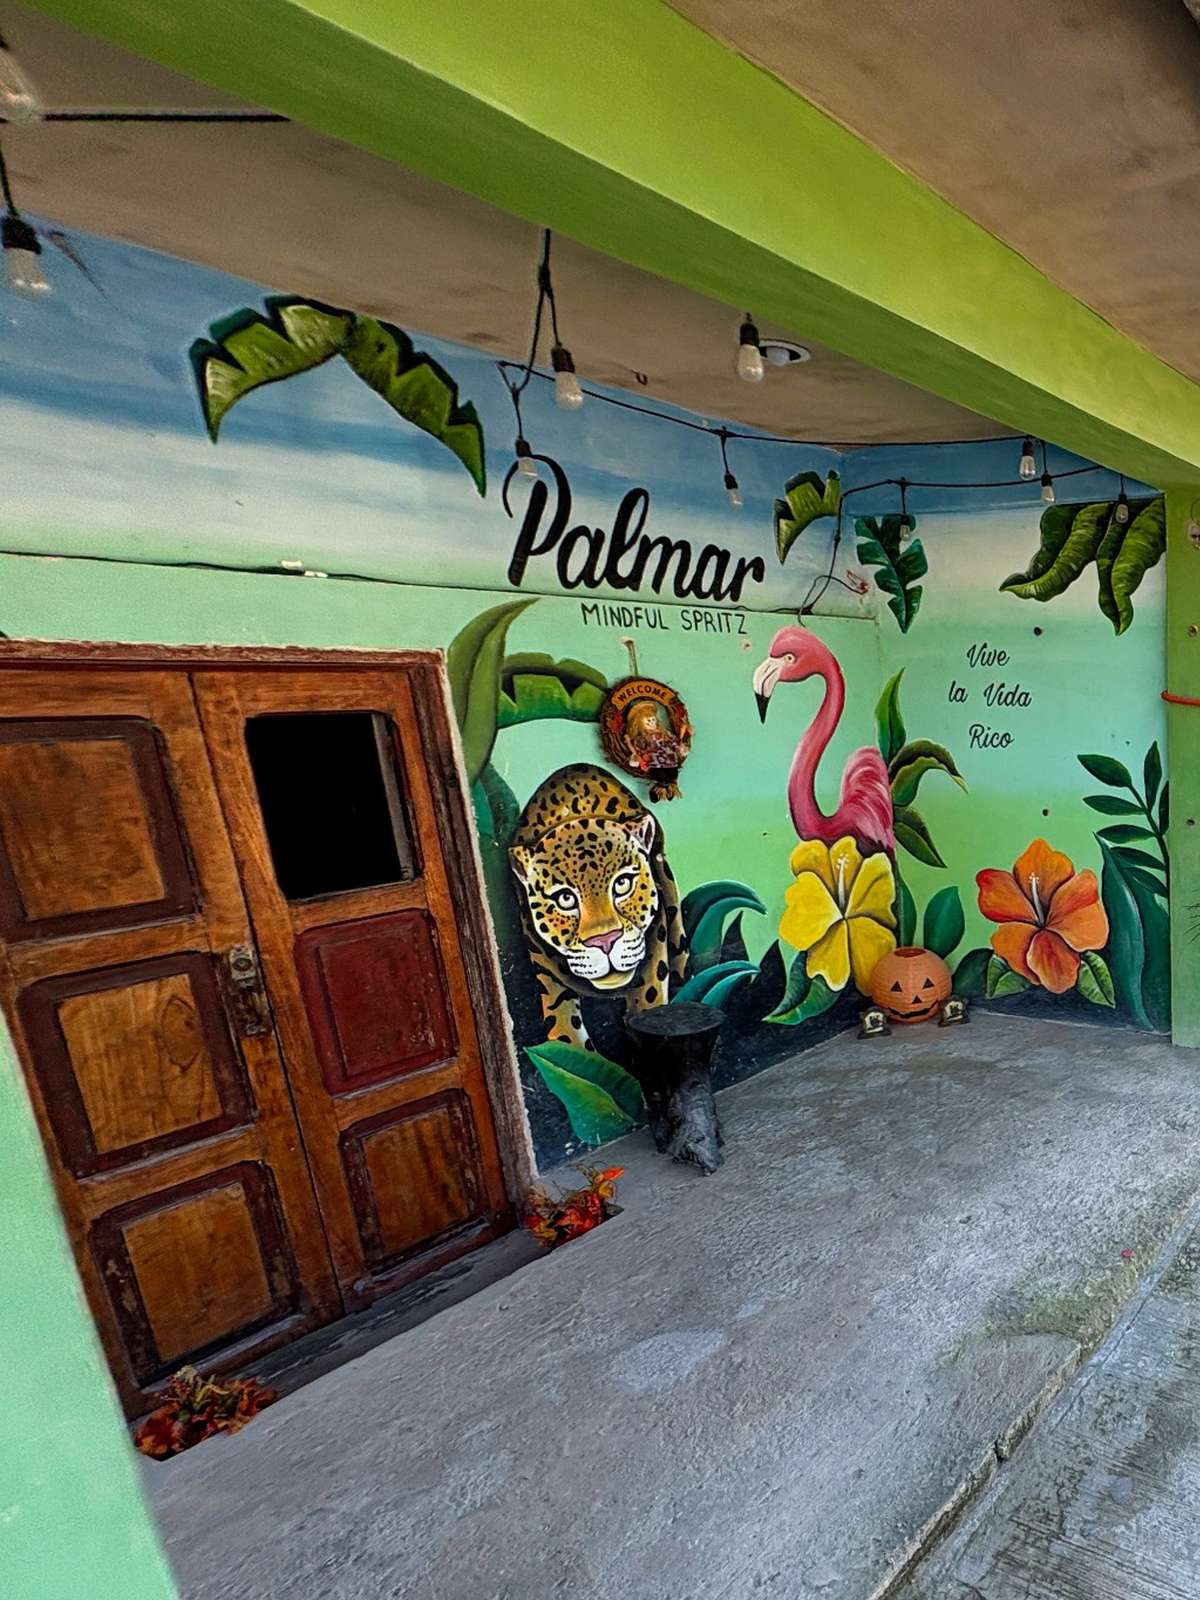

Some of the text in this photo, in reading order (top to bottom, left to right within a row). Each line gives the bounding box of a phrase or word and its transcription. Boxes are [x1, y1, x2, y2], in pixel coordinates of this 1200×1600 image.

[503, 454, 765, 601] Palmar
[580, 603, 748, 635] MINDFUL SPRITZ
[966, 642, 1011, 668] Vive
[616, 685, 668, 703] WELCOME
[948, 680, 1032, 707] la Vida
[968, 723, 1015, 749] Rico
